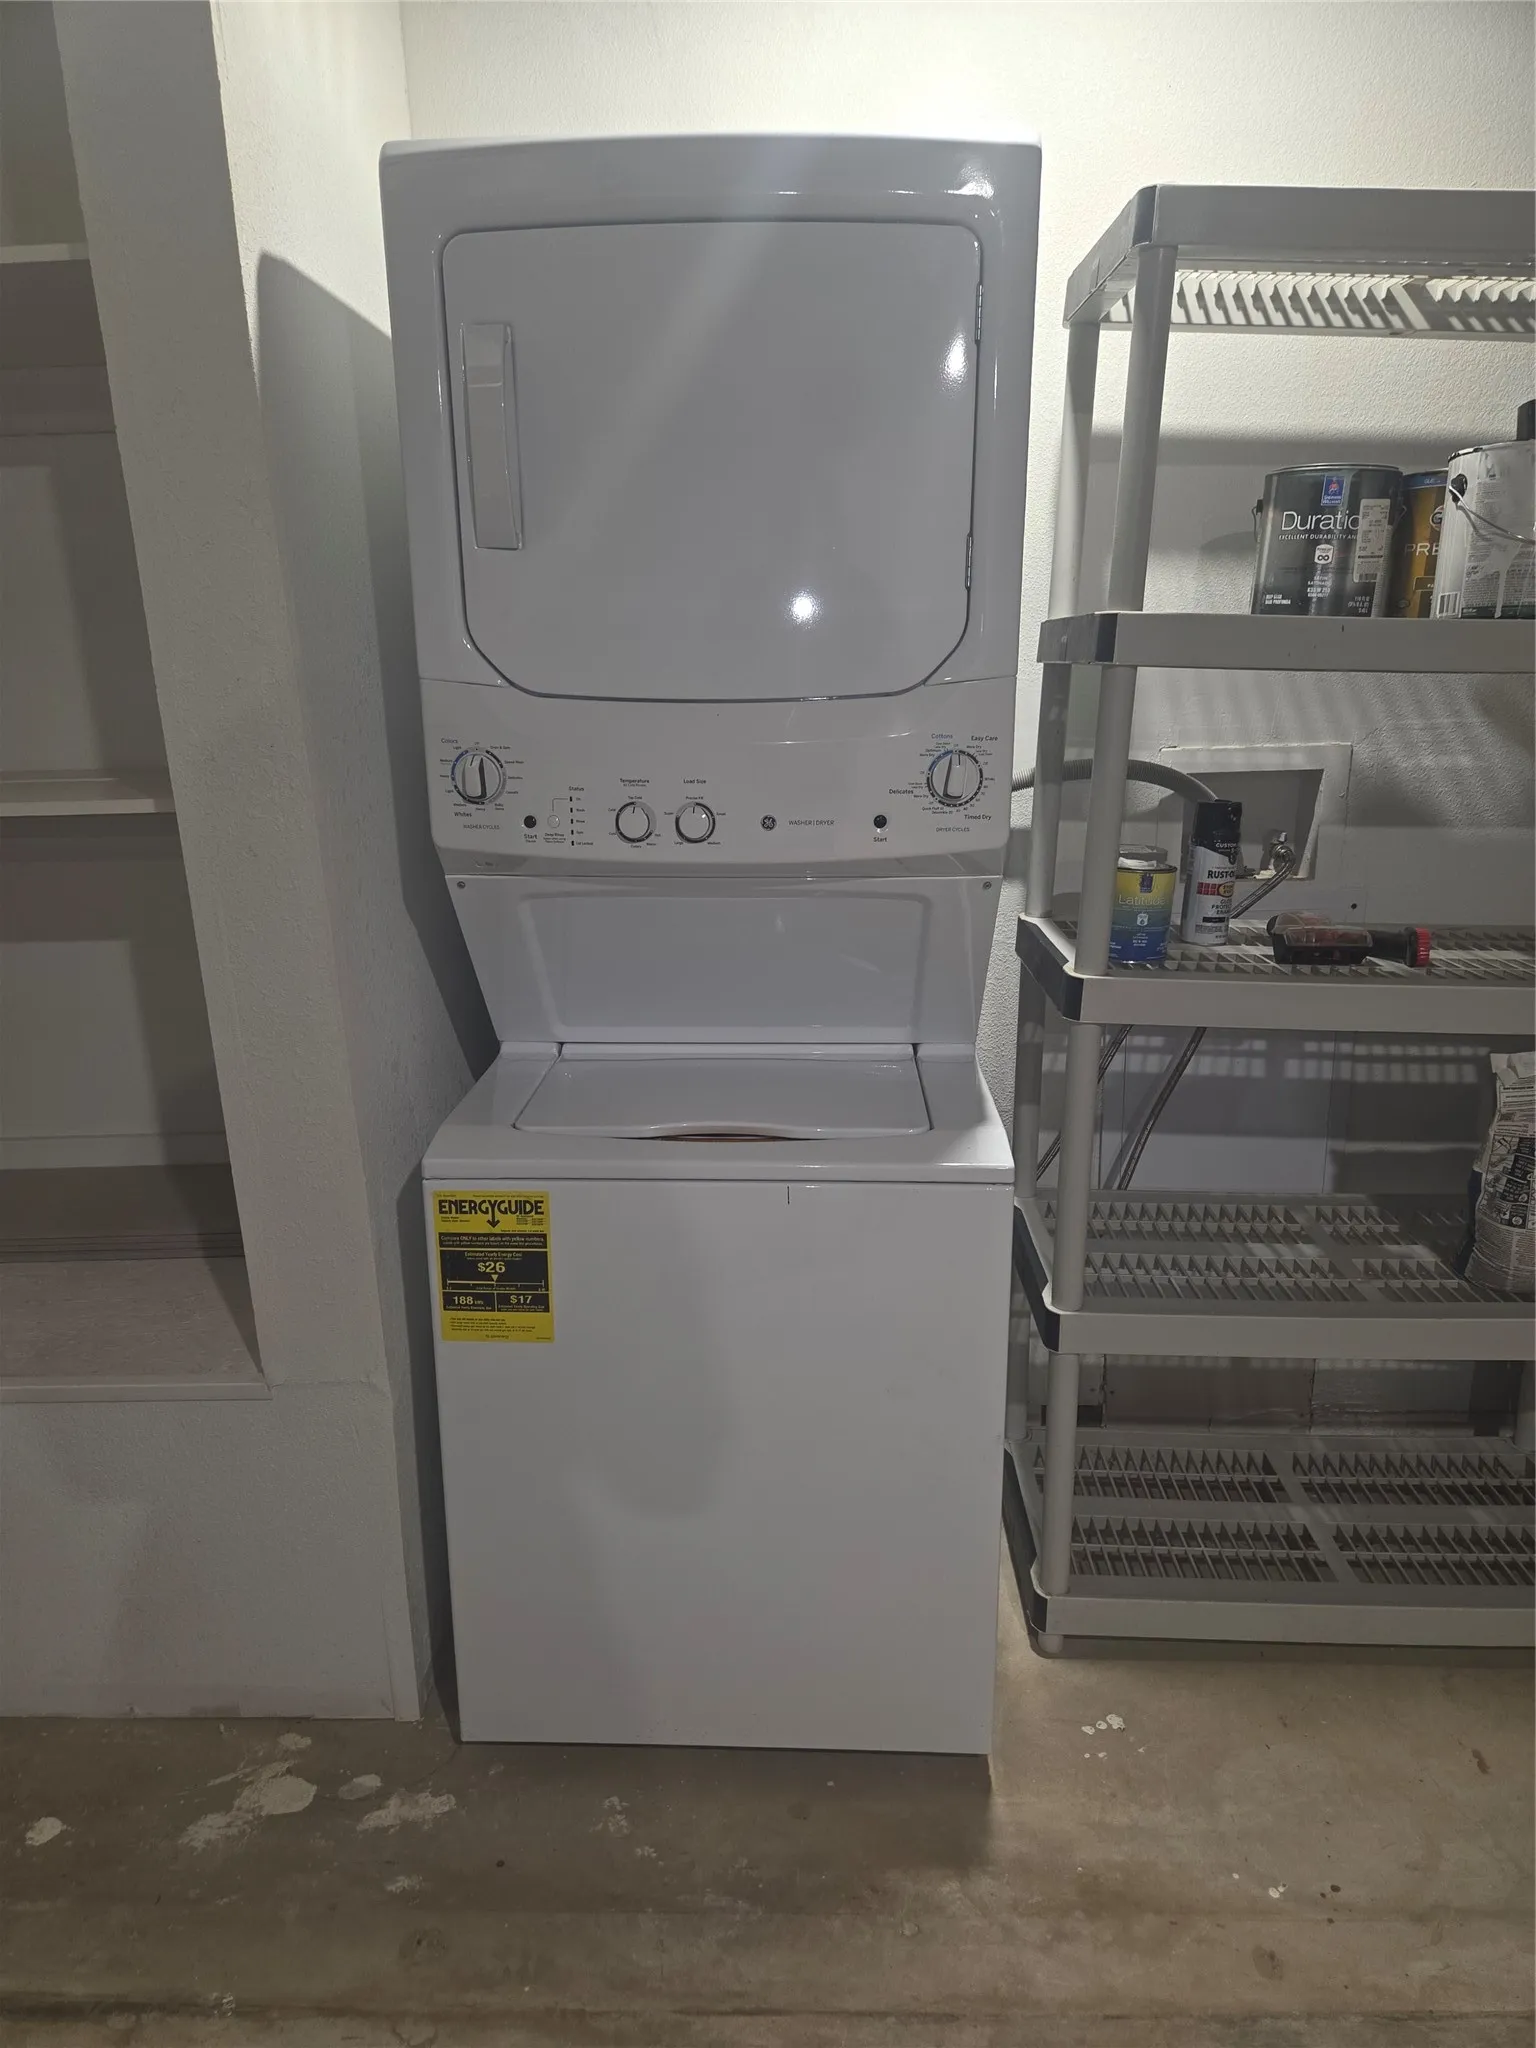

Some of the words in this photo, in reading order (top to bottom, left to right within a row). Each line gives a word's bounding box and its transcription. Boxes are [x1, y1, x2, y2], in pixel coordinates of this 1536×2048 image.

[1119, 894, 1166, 906] Latitude
[438, 1199, 544, 1215] ENERGYGUIDE
[477, 1261, 506, 1273] $26
[452, 1296, 474, 1305] 188
[510, 1295, 532, 1304] $17
